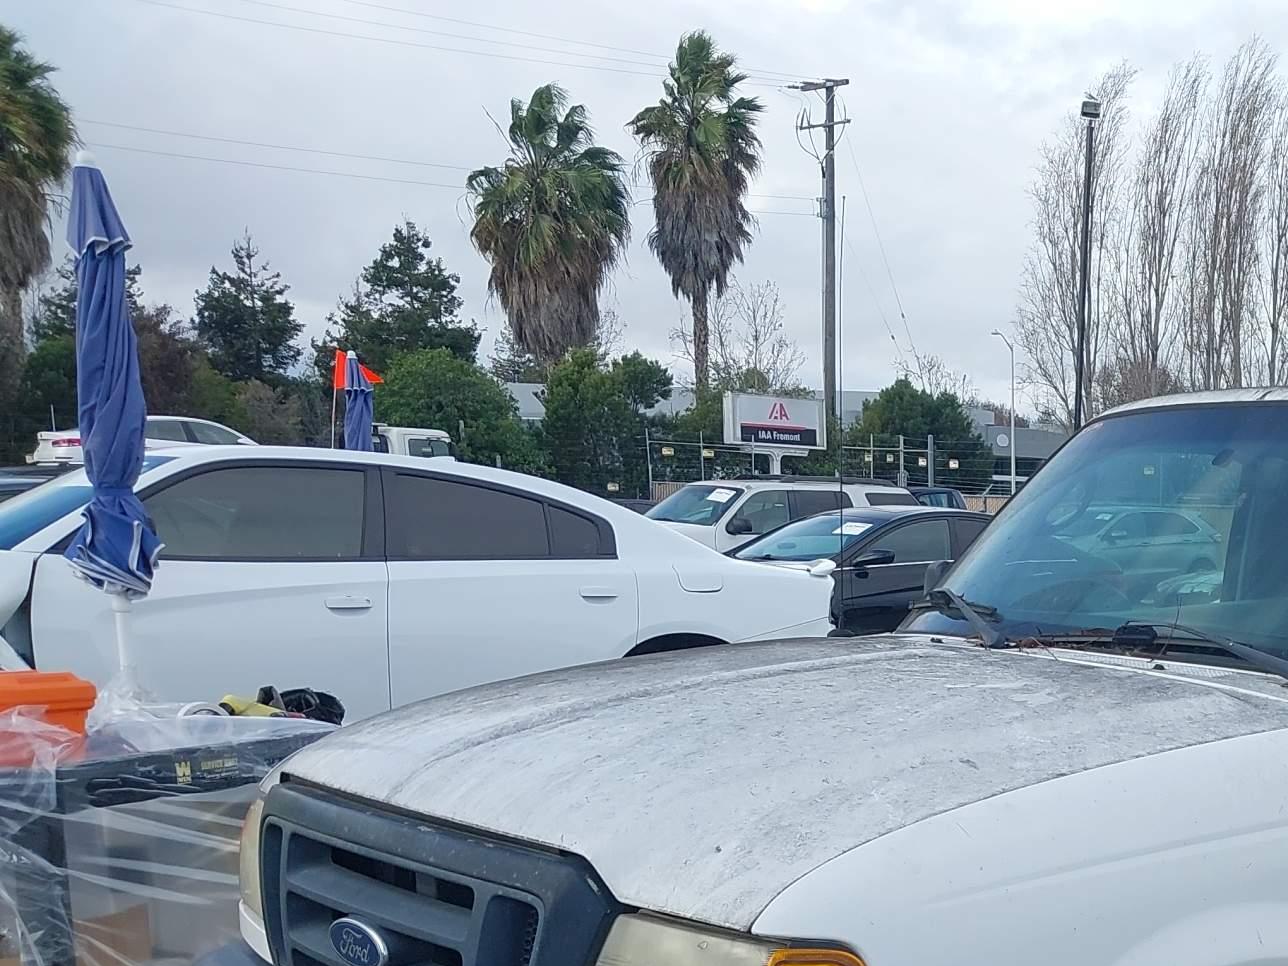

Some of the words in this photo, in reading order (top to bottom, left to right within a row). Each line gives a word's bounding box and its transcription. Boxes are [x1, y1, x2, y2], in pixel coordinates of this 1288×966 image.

[758, 430, 772, 441] IAA
[773, 431, 801, 442] Fremont
[339, 927, 371, 963] Ford
